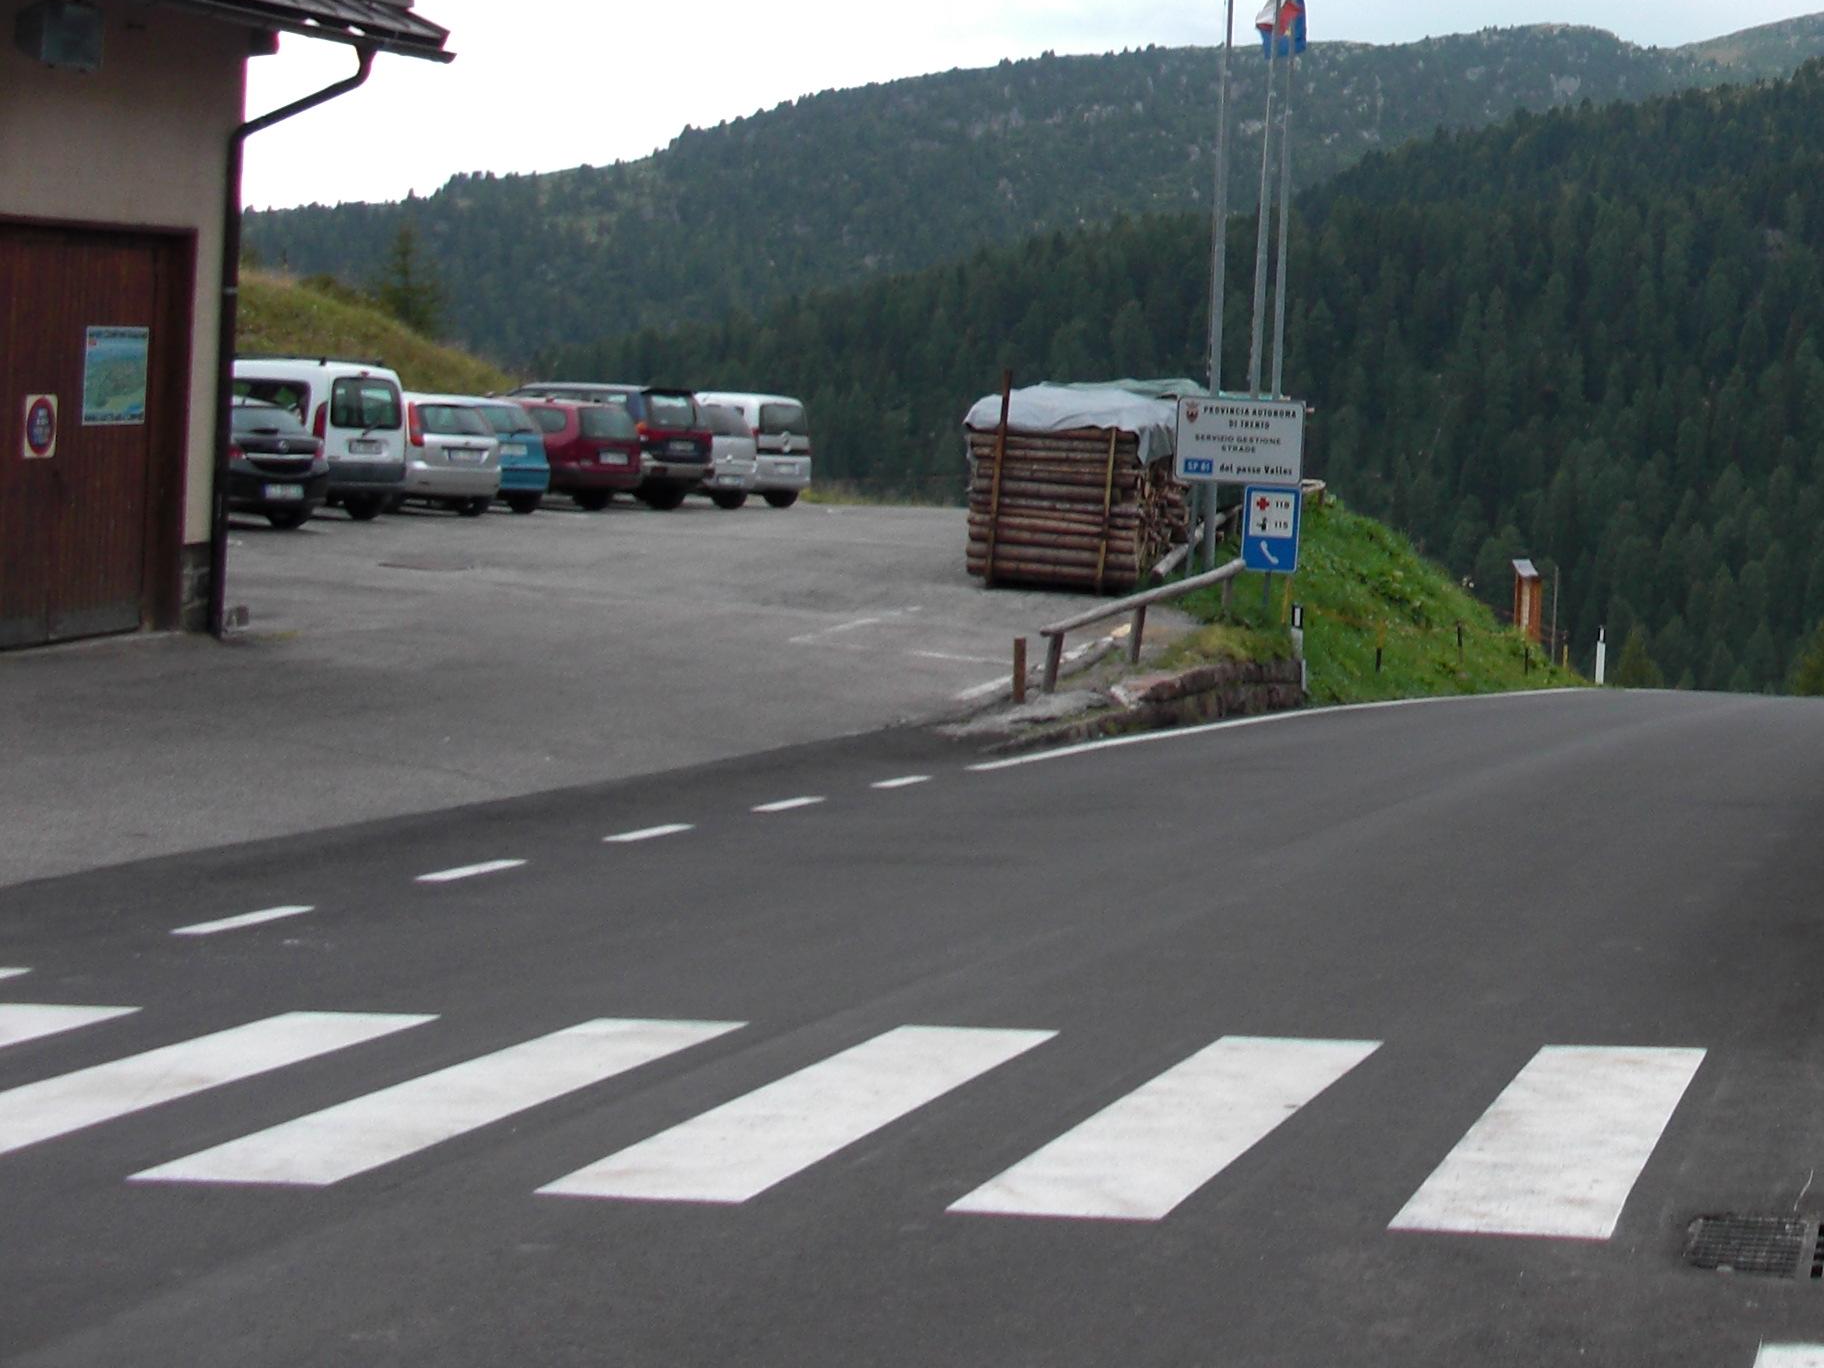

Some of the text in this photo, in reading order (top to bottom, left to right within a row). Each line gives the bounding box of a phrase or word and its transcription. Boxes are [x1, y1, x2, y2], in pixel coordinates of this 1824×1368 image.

[1203, 405, 1297, 419] PROVINCIA AUTONOMA
[1228, 420, 1270, 430] DI TRENTO
[1195, 434, 1282, 446] SERVIZIO GESTIONE
[1221, 445, 1257, 454] STRADE
[1236, 465, 1261, 476] passo
[1264, 464, 1293, 476] Valles
